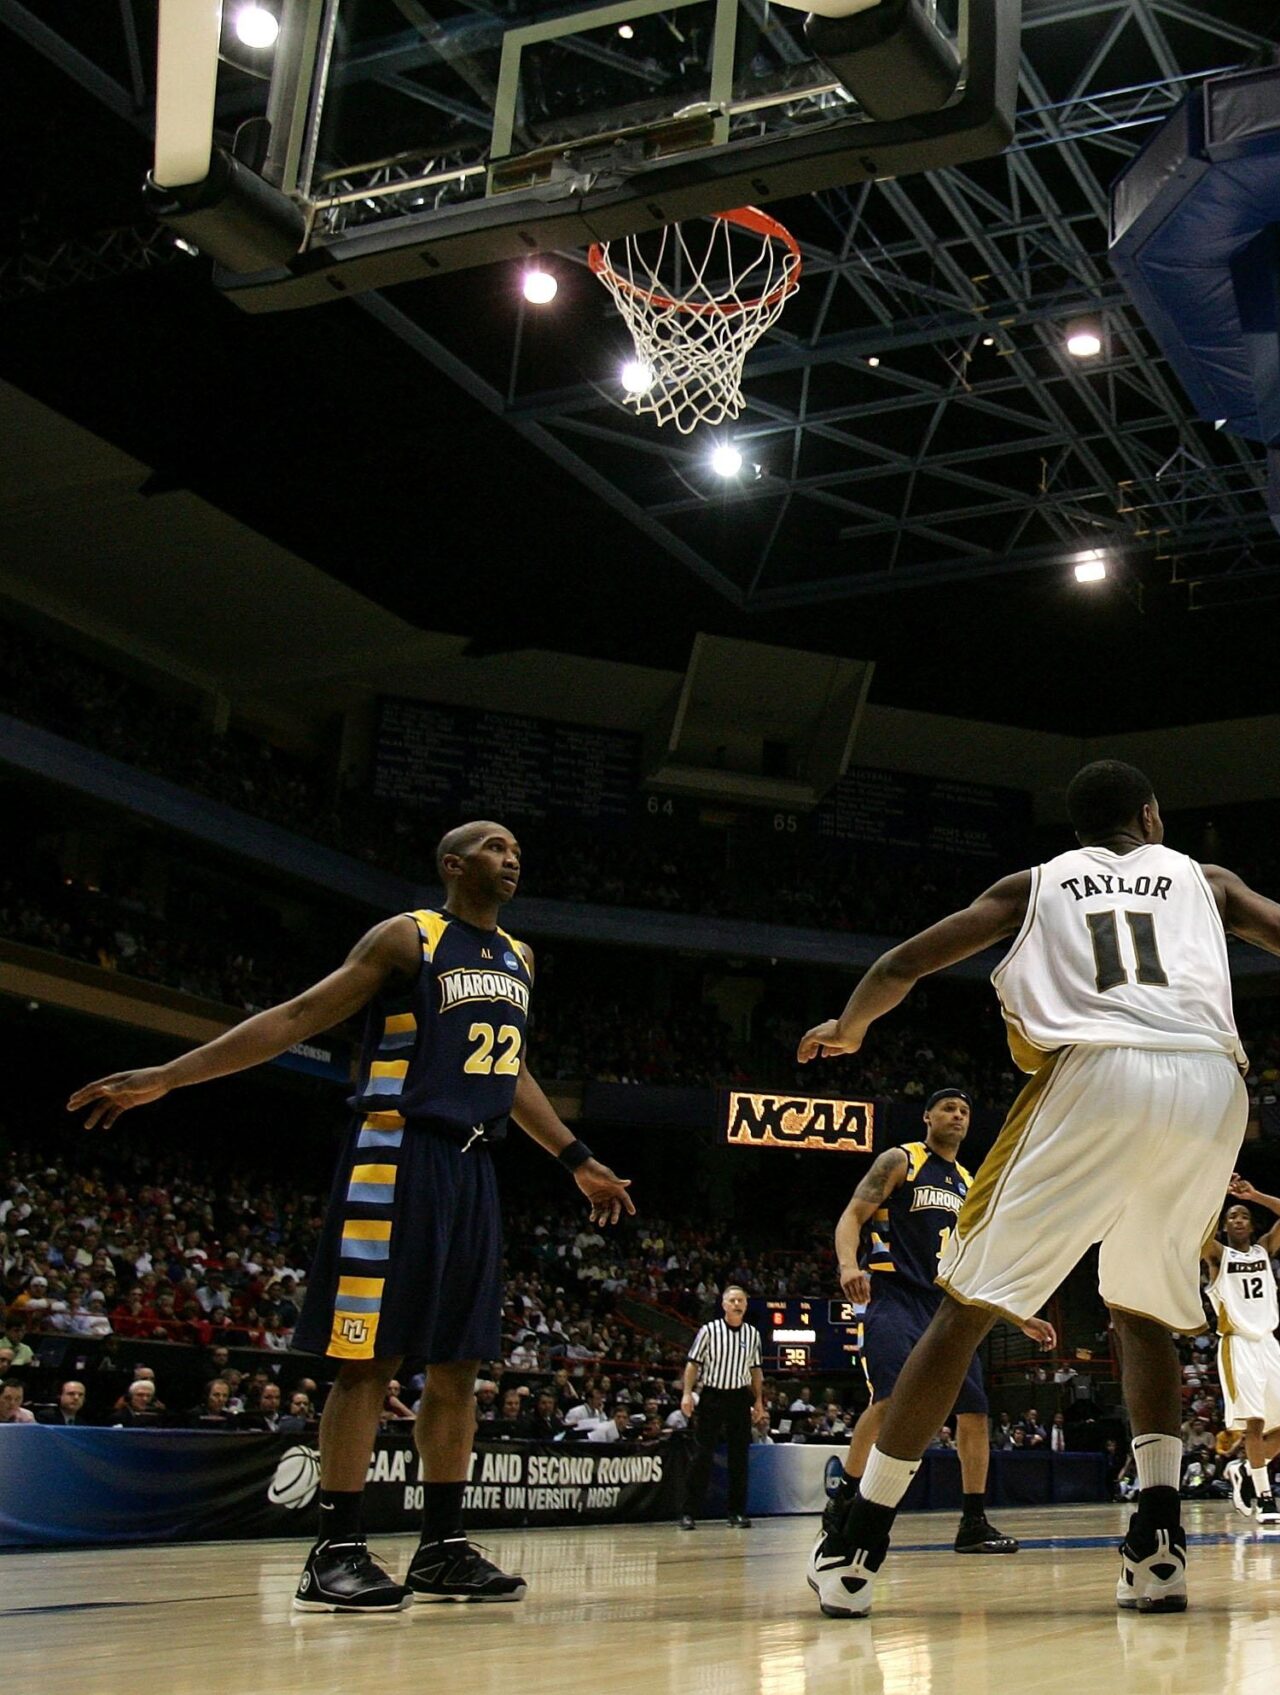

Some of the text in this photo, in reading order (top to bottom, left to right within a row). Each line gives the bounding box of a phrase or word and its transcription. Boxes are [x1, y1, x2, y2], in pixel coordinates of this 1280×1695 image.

[648, 796, 674, 816] 64
[773, 813, 798, 832] 65
[1060, 874, 1173, 901] TAYLOR
[481, 948, 493, 959] AL
[1085, 909, 1169, 994] 11
[464, 1022, 521, 1076] 22
[730, 1096, 867, 1147] NCAA
[1242, 1277, 1264, 1299] 12
[342, 1318, 369, 1344] MU
[481, 1453, 522, 1484] AND
[528, 1455, 594, 1485] SECOND
[597, 1455, 663, 1484] ROUNDS
[586, 1487, 621, 1508] HOST
